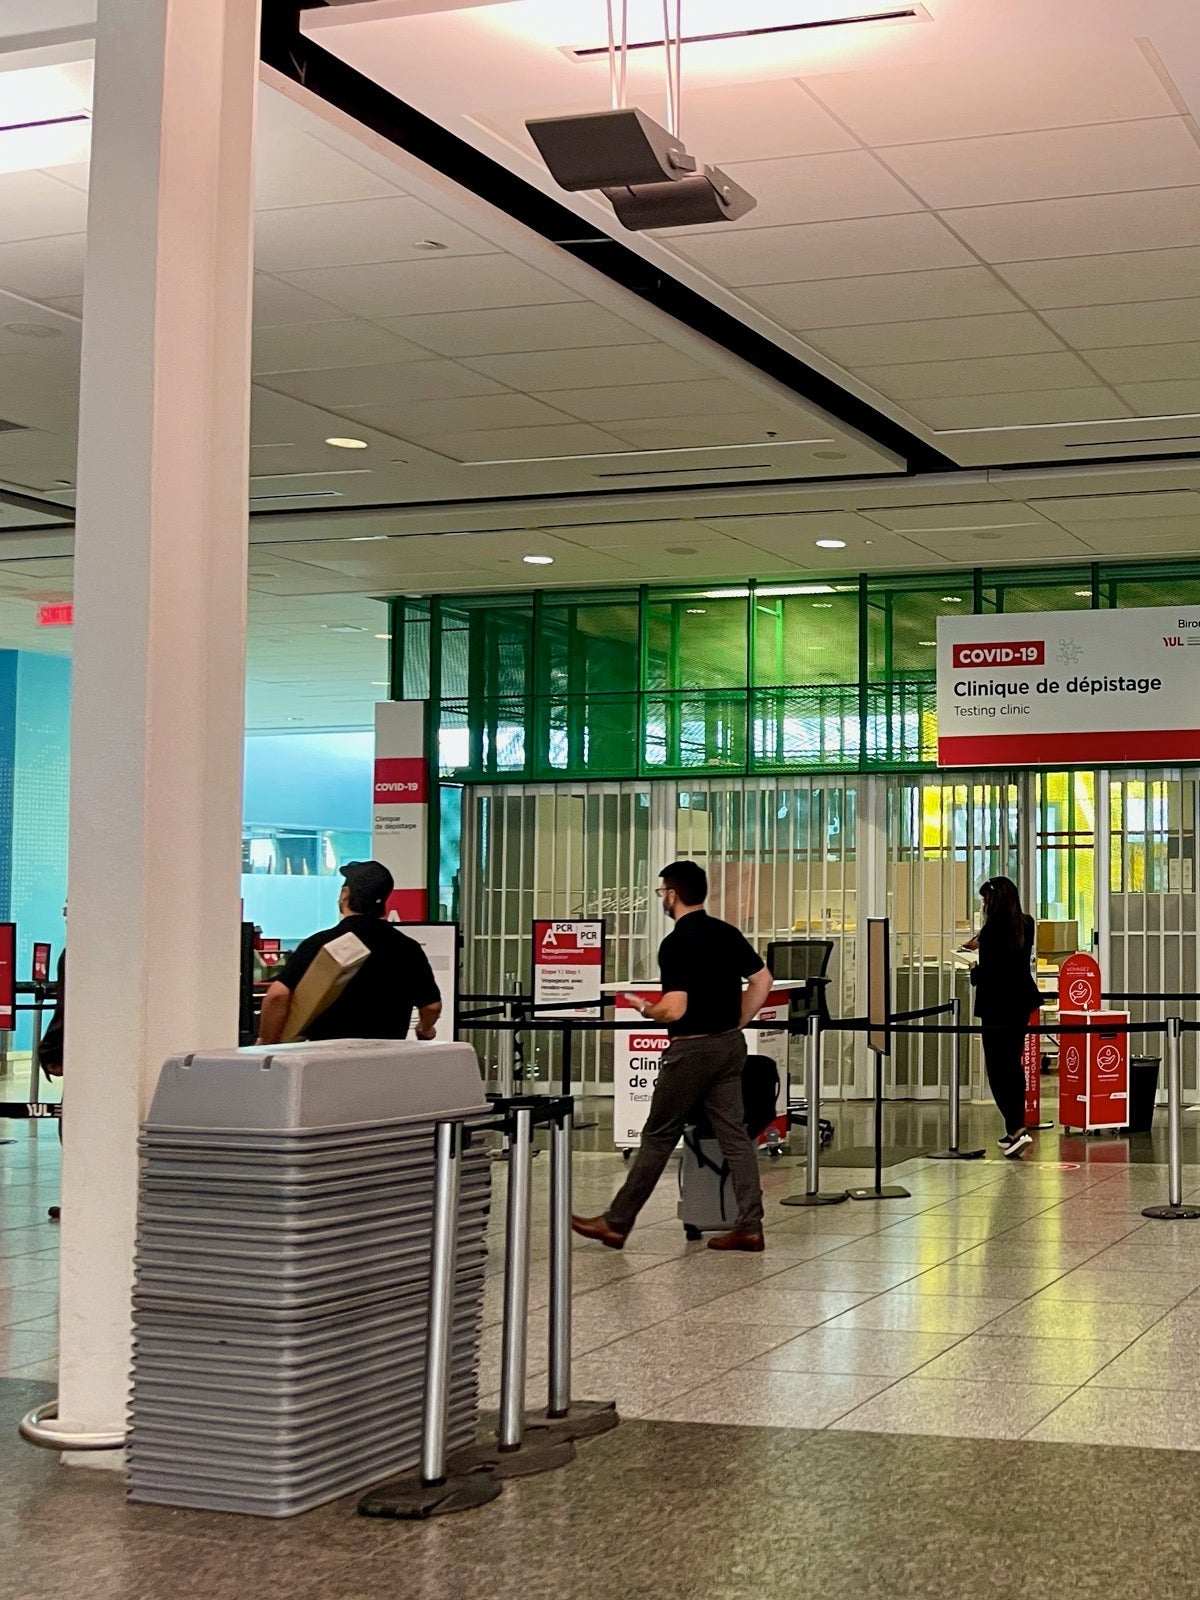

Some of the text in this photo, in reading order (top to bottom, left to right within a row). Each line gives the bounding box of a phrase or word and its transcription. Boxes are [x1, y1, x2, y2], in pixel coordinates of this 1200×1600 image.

[1162, 637, 1184, 647] YUL
[959, 647, 1038, 664] COVID-19
[953, 676, 1162, 698] Clinique de dépistage
[953, 704, 1030, 717] Testing clinic
[375, 782, 418, 791] COVID-19
[556, 924, 573, 932] PCR
[542, 929, 557, 945] A
[580, 932, 597, 940] PCR
[629, 1075, 648, 1088] de
[26, 1103, 52, 1117] YUL
